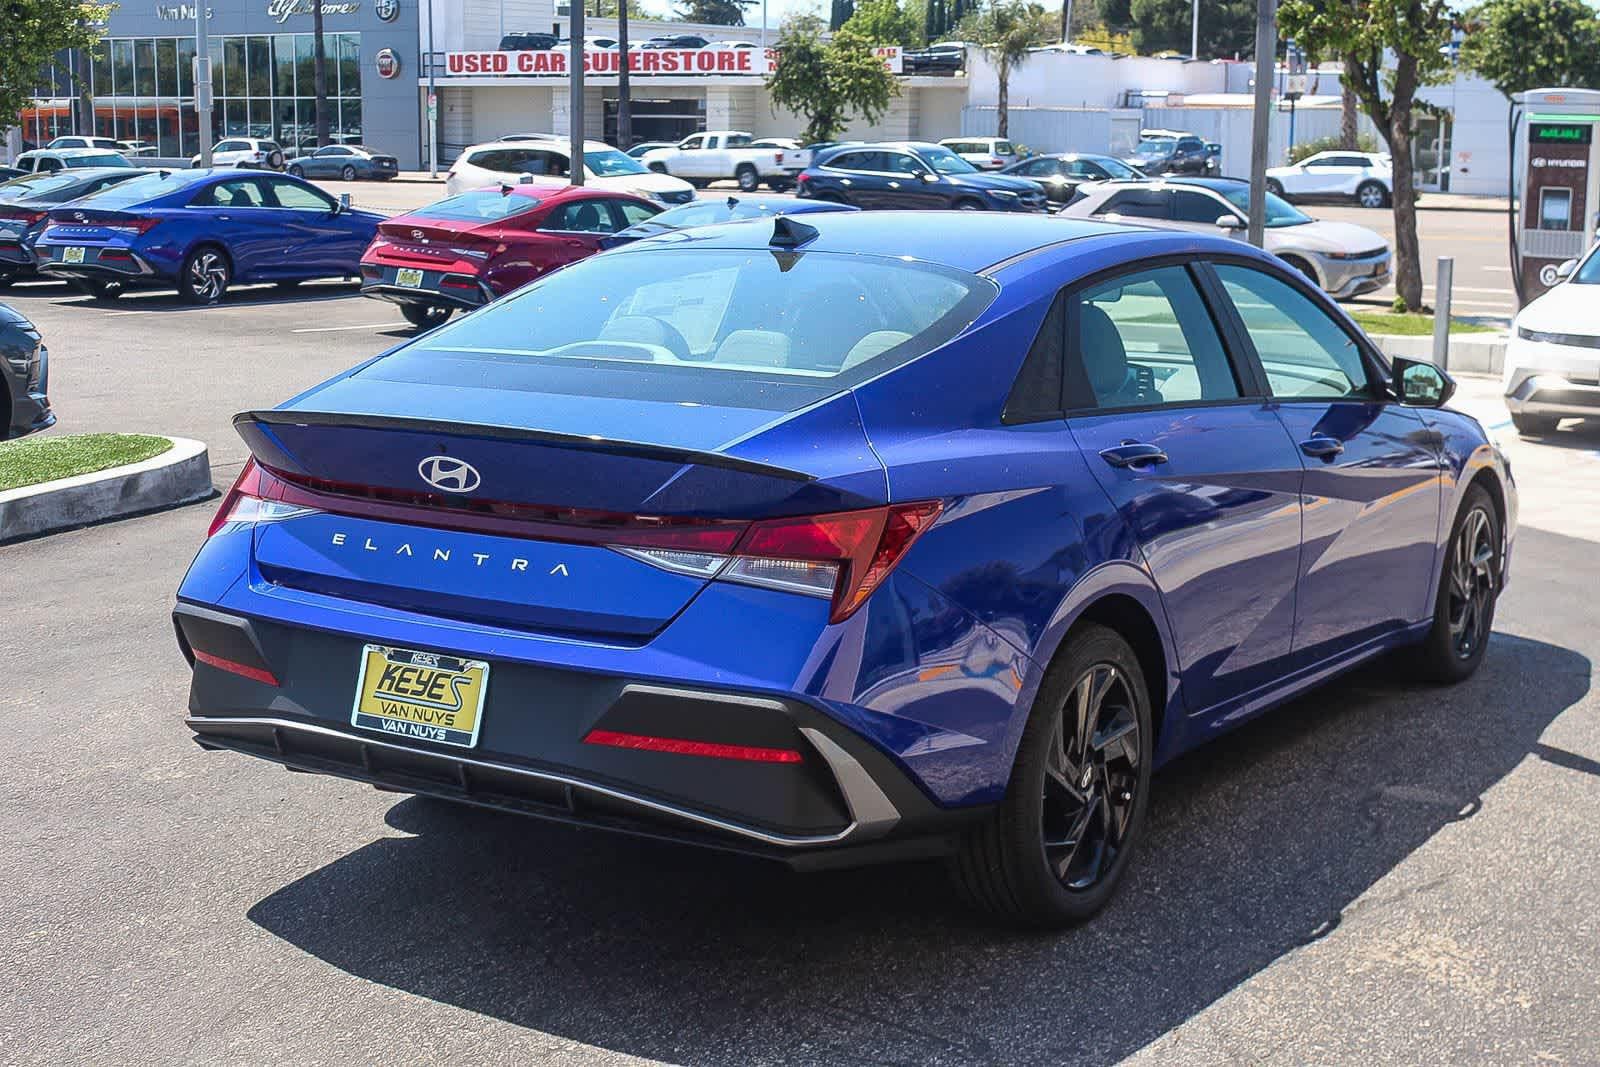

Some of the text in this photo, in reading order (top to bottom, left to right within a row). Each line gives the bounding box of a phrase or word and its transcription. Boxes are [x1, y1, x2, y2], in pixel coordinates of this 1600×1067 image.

[180, 4, 214, 20] Nus
[450, 54, 508, 72] USED
[517, 53, 566, 72] CAR
[332, 533, 569, 576] ELANTRA
[375, 664, 472, 712] KEYES
[381, 701, 455, 726] VAN NUYS
[381, 718, 447, 740] VAN NUYS
